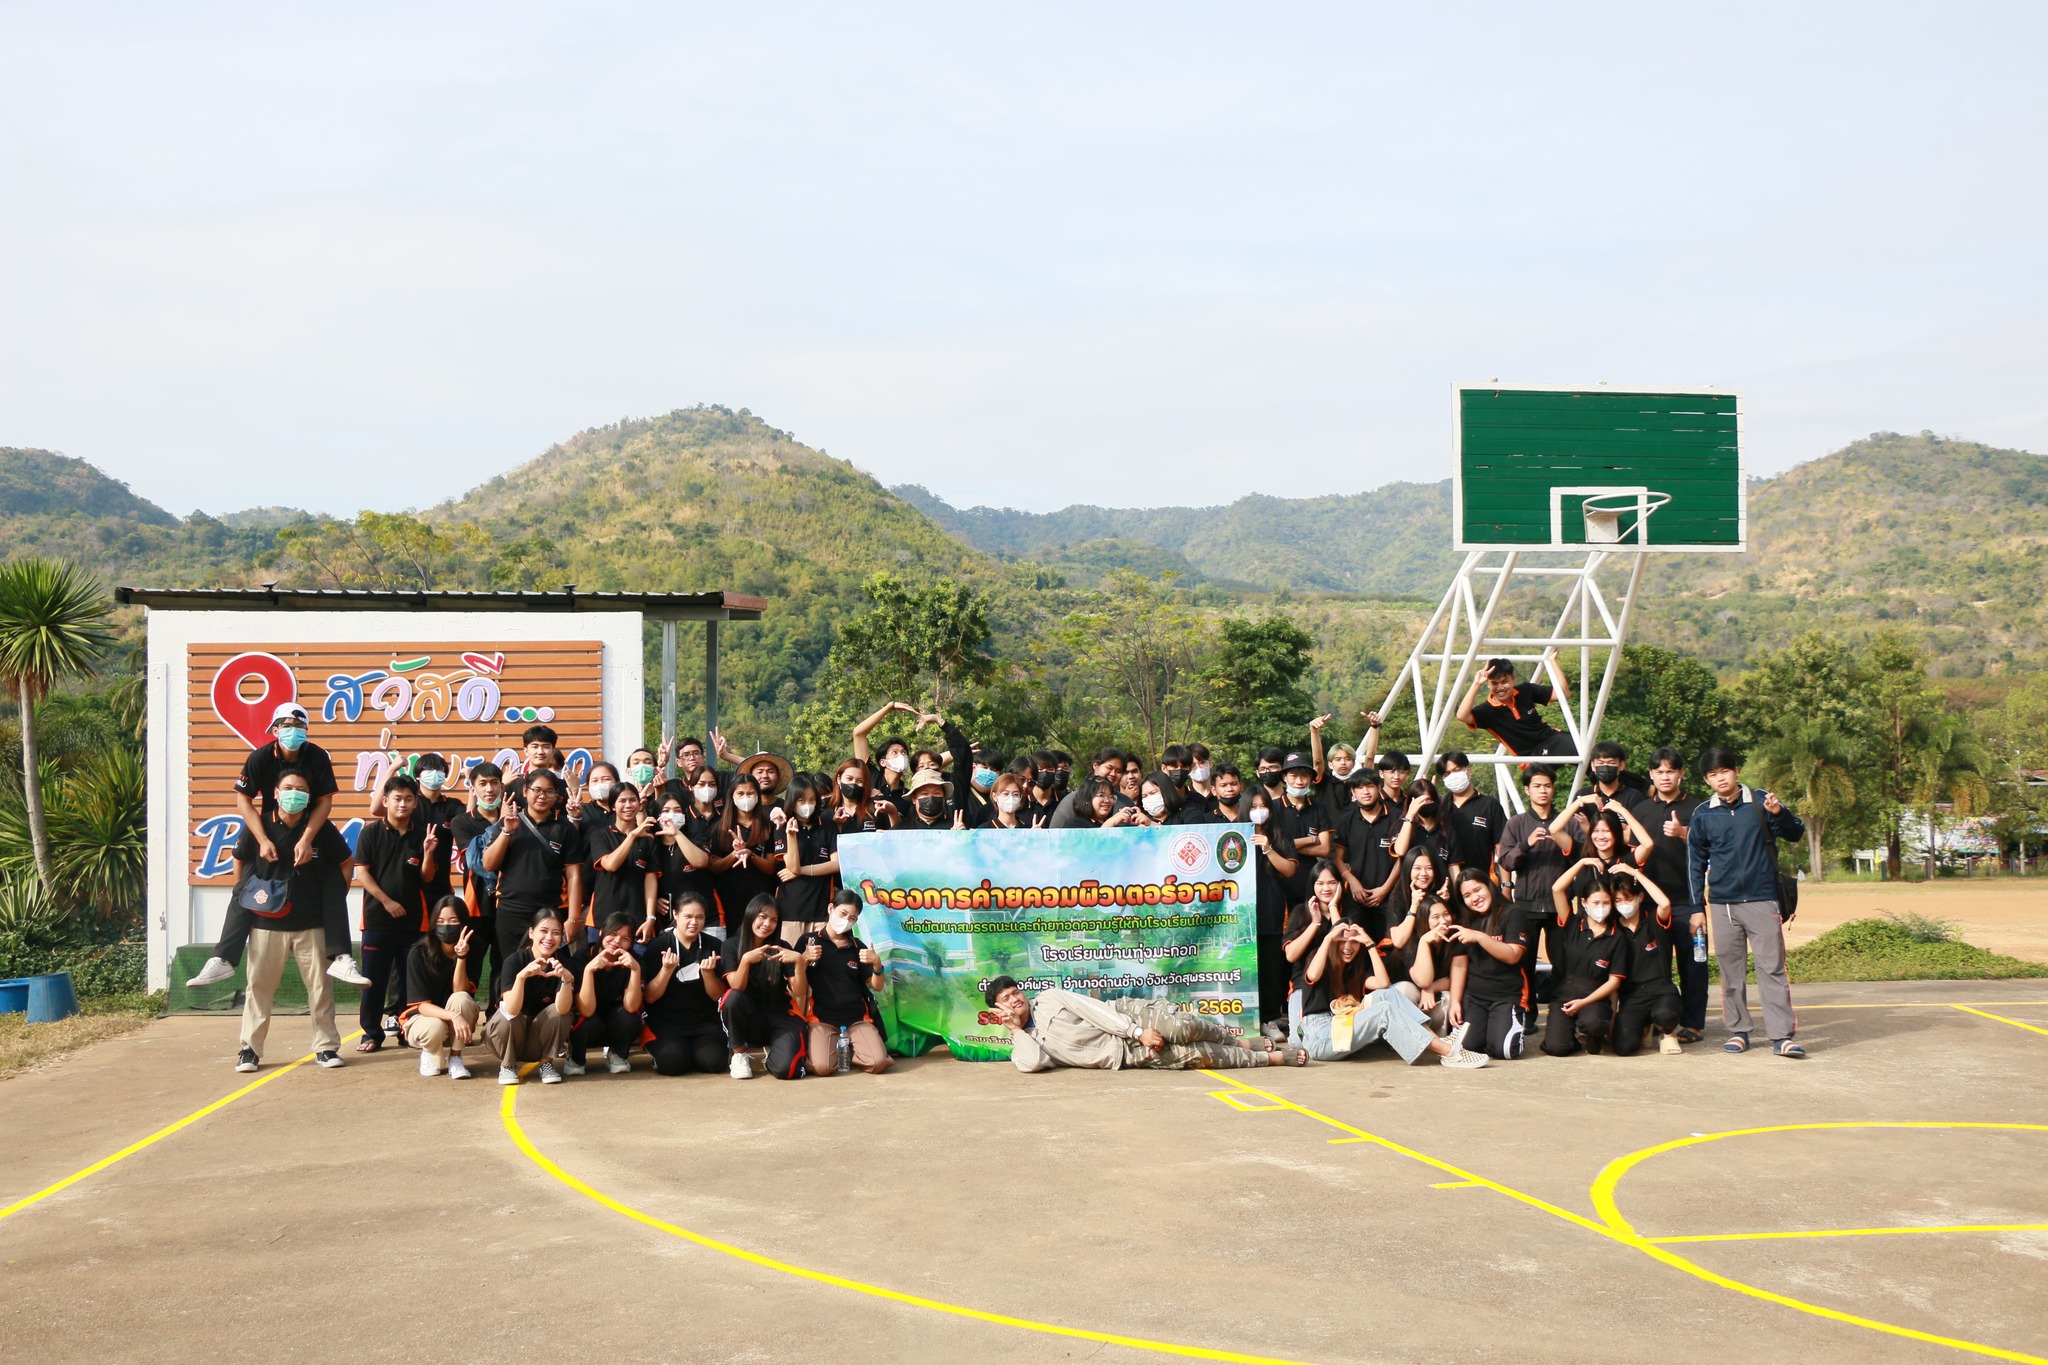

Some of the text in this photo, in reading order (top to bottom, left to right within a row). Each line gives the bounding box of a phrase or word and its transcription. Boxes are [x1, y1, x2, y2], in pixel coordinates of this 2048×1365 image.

[1042, 943, 1198, 963] โรงเรียนบ้านทุ่งมะกอก
[1063, 973, 1144, 990] อำเภอด่านช้าง
[1146, 968, 1242, 987] จังหวัดสุพรรณบุรี
[1198, 999, 1243, 1015] 2566
